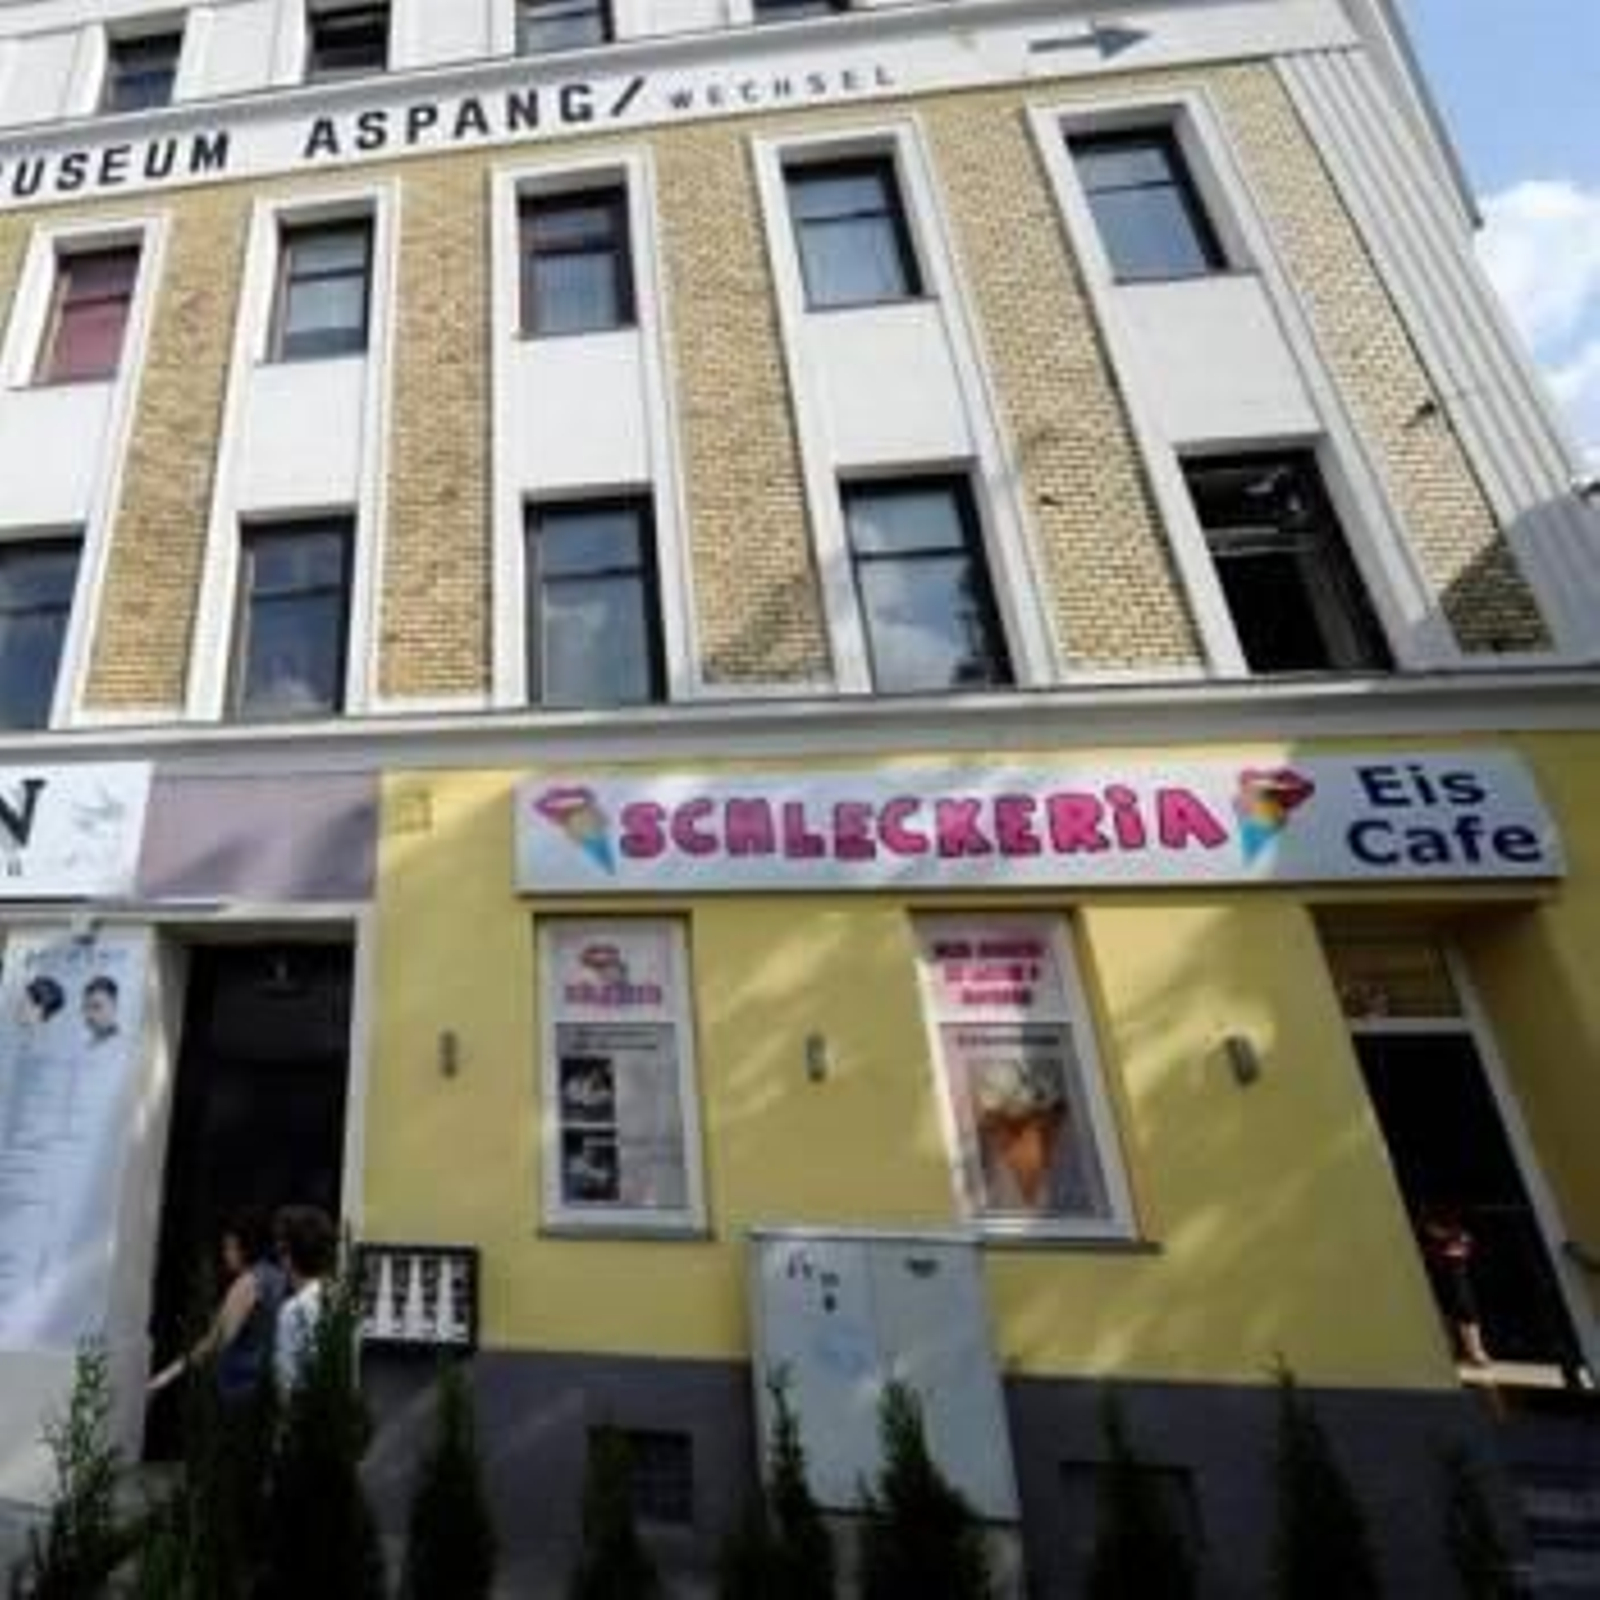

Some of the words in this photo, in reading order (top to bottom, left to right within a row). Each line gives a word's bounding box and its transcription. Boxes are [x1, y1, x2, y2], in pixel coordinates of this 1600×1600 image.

[0, 131, 228, 197] USEUM
[669, 64, 895, 109] WECHSEL
[1354, 764, 1486, 808] Eis
[1346, 814, 1544, 866] Cafe
